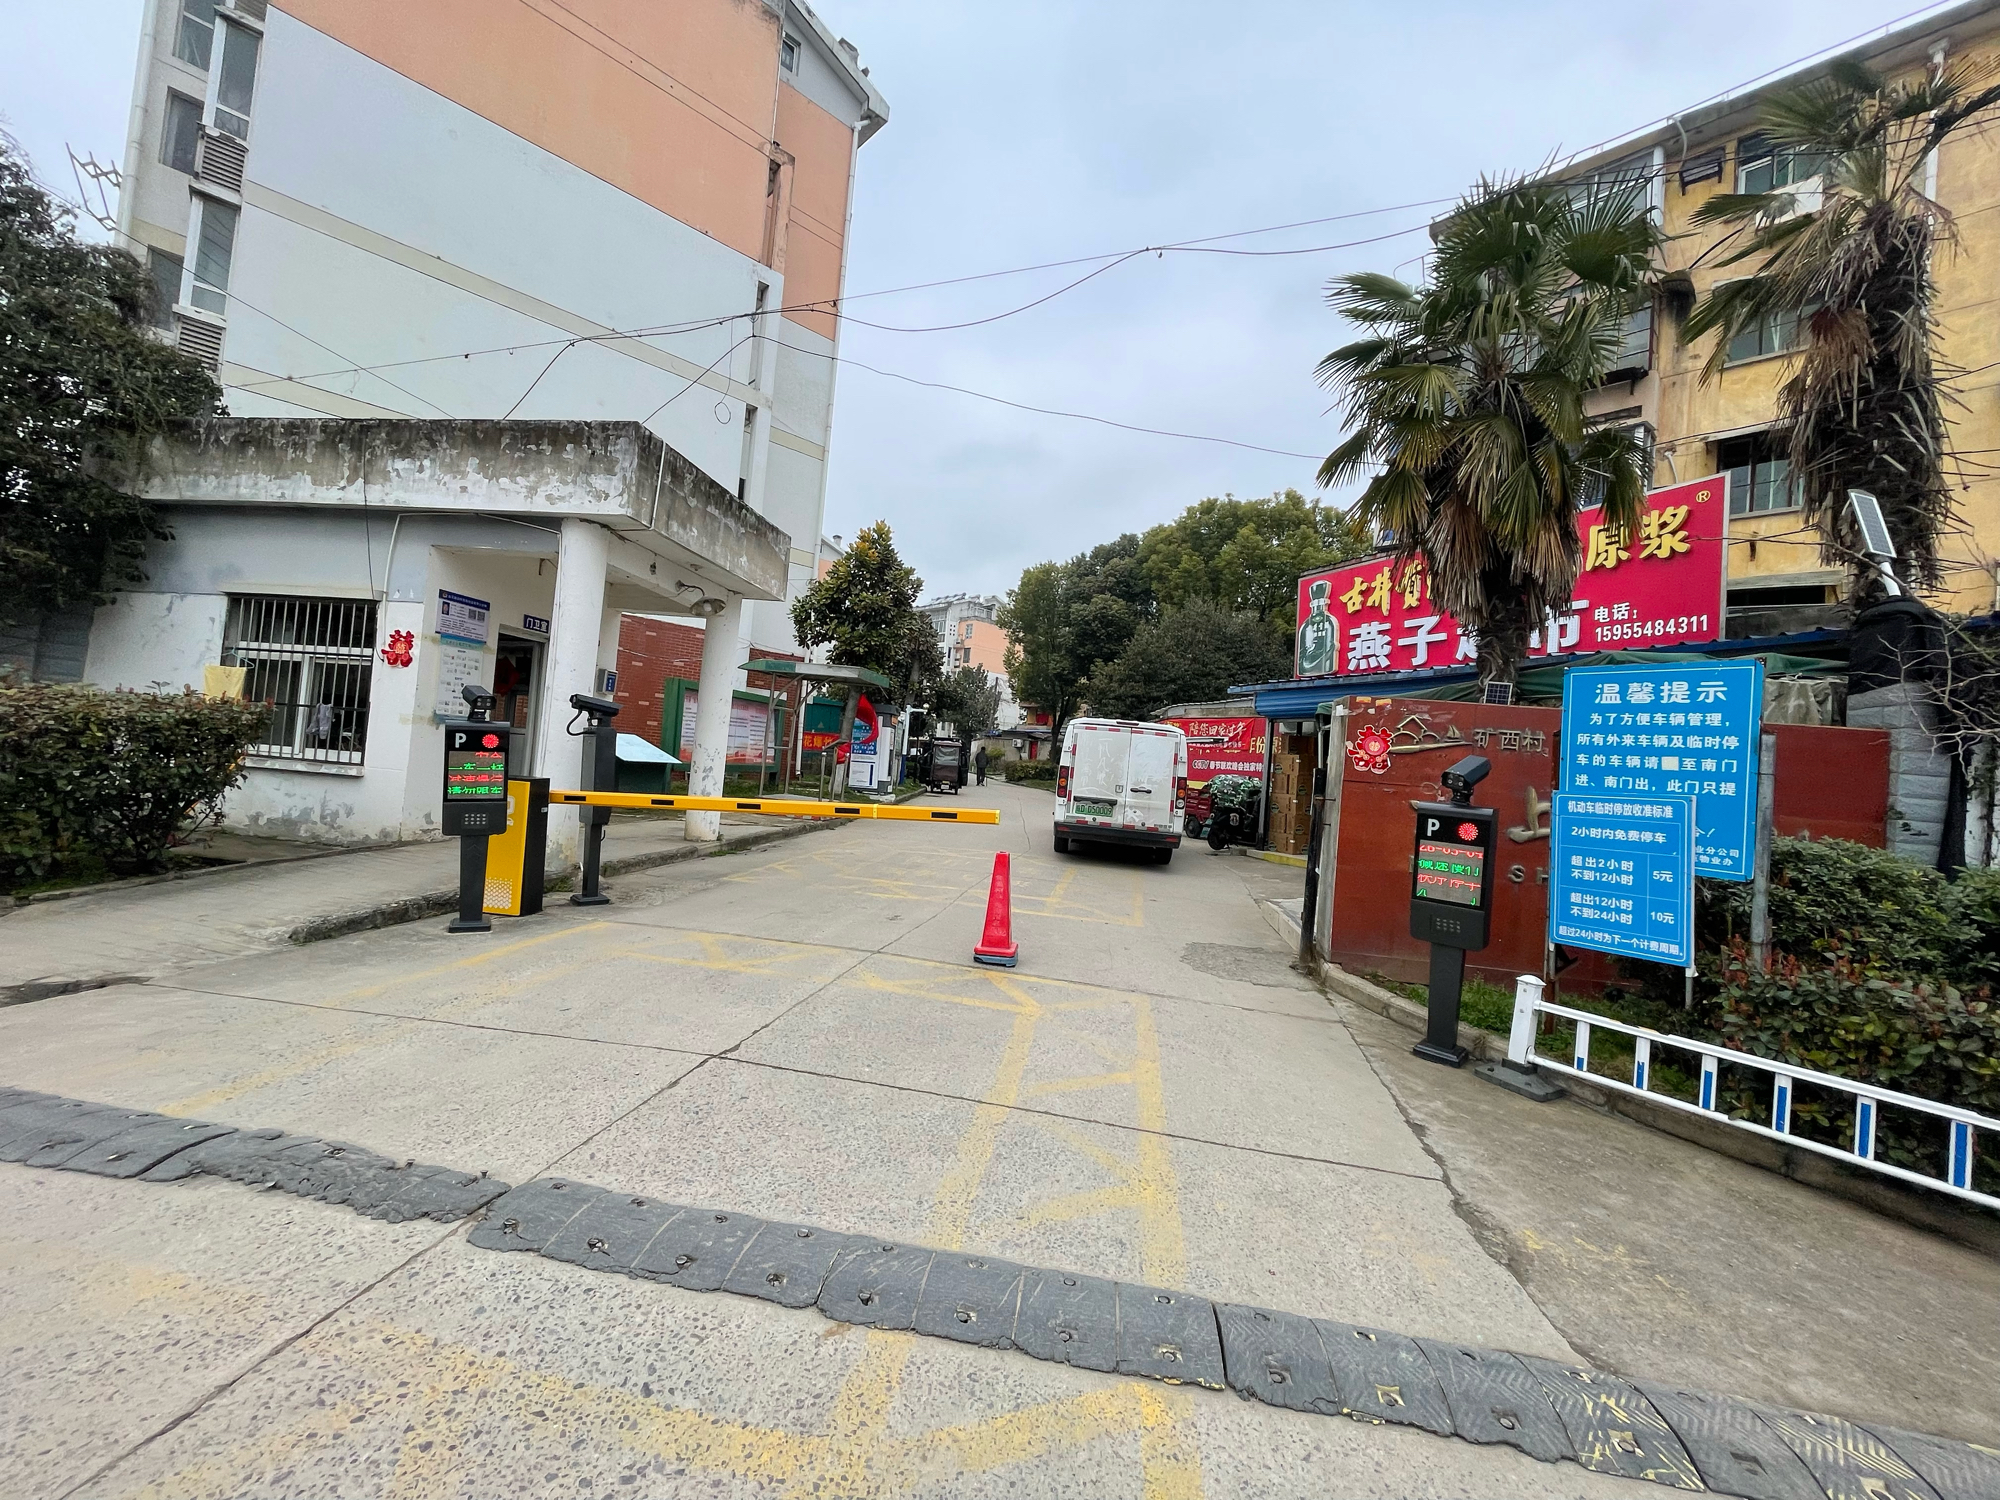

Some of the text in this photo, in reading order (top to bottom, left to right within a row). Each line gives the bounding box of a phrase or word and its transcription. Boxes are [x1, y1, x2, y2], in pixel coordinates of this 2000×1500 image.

[1585, 505, 1690, 571] 原浆
[526, 617, 548, 632] 门卫室
[1595, 615, 1708, 643] 15955484311
[1594, 681, 1728, 704] 温馨提示
[1589, 712, 1730, 727] 为了方便车辆管理，
[454, 733, 467, 749] P
[1576, 733, 1740, 750] 所有外来车辆及临时停
[1575, 753, 1738, 773] 车的车辆请至南门
[1426, 818, 1440, 836] P
[1571, 826, 1667, 844] 2小时内免费停车
[1570, 855, 1634, 872] 超出2小时
[1570, 868, 1634, 886] 不到12小时
[1652, 871, 1674, 883] 5元
[1570, 891, 1633, 911] 超出12小时
[1570, 905, 1633, 925] 不到24小时
[1650, 912, 1675, 925] 10元
